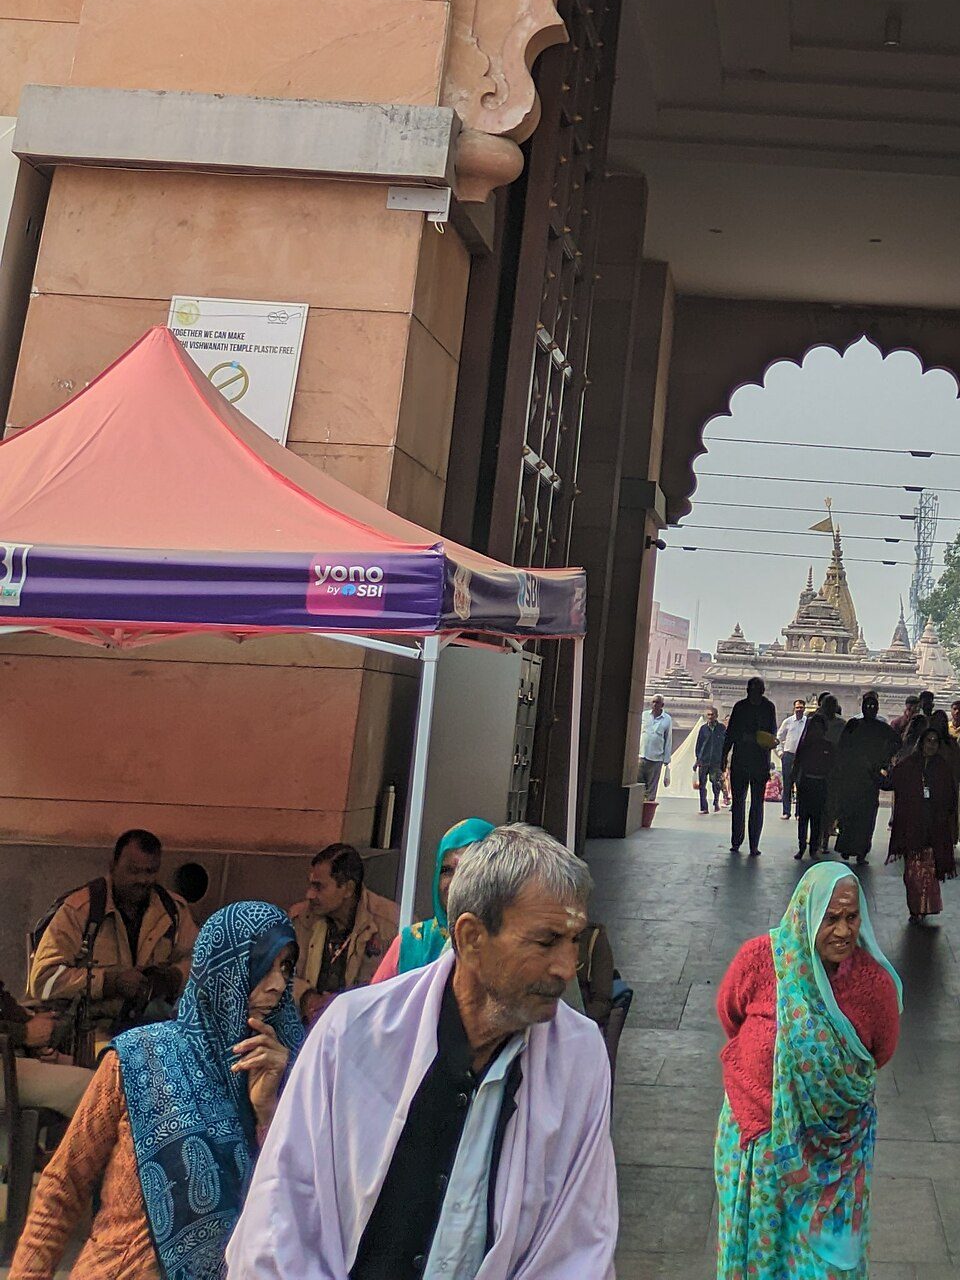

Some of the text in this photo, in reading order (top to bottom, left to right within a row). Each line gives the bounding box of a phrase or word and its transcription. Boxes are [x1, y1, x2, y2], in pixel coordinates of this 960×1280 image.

[172, 328, 245, 340] TOGETHER WE CAN MAKE
[189, 341, 228, 351] VISHWANATH
[229, 343, 253, 352] TEMPLE
[254, 345, 278, 353] PLASTIC
[314, 565, 384, 586] yono
[327, 584, 384, 598] by SBI
